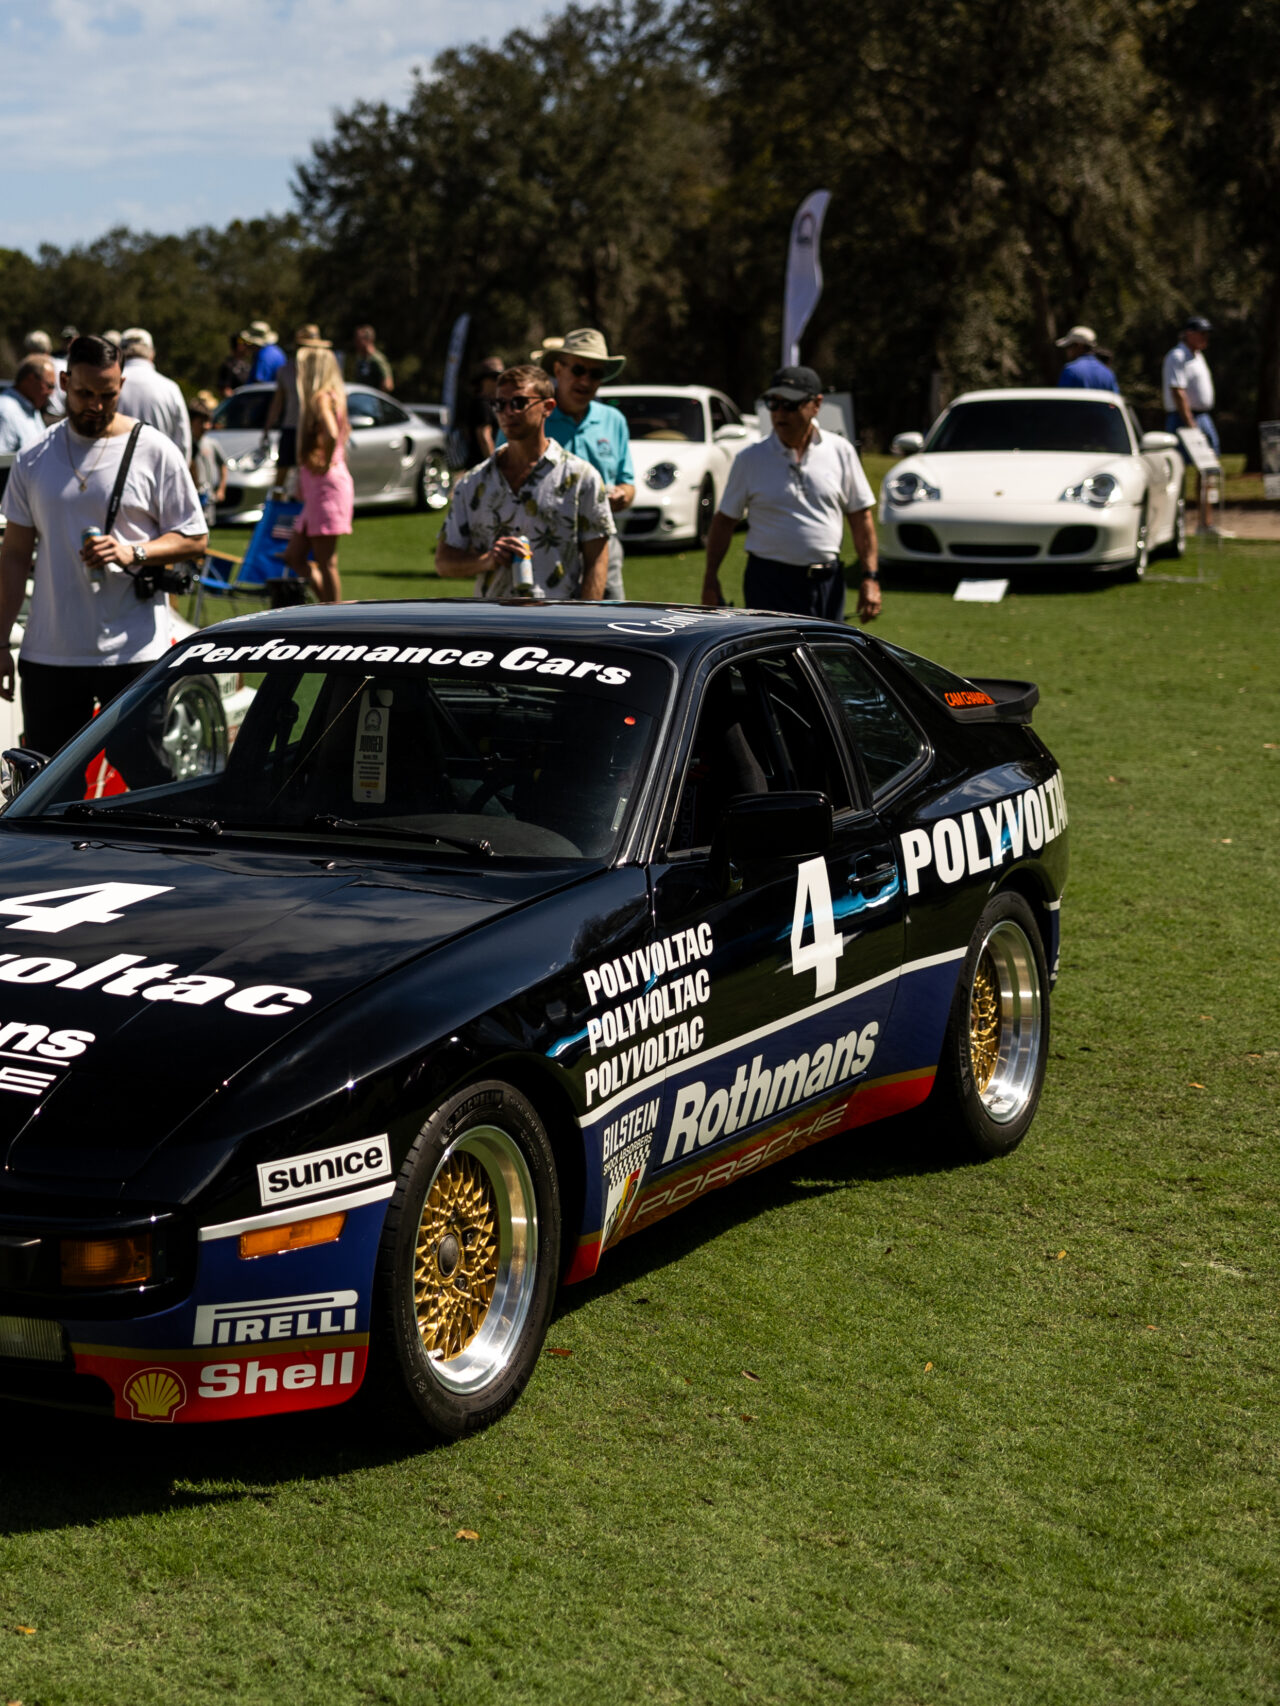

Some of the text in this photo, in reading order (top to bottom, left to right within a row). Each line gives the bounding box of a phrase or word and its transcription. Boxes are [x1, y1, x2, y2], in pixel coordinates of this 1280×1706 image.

[168, 637, 632, 687] Performance Cars
[790, 855, 844, 998] 4
[583, 922, 714, 1007] POLYVOLTAC
[586, 968, 711, 1056] POLYVOLTAC
[585, 1016, 704, 1107] POLYVOLTAC
[662, 1021, 879, 1166] Rothmans
[603, 1097, 661, 1163] BILSTEIN
[603, 1131, 654, 1177] SHOCK ABSORBERS
[633, 1103, 848, 1223] PORSCHE
[268, 1146, 384, 1194] sunice
[192, 1289, 359, 1345] PIRELLI
[198, 1351, 355, 1399] Shell
